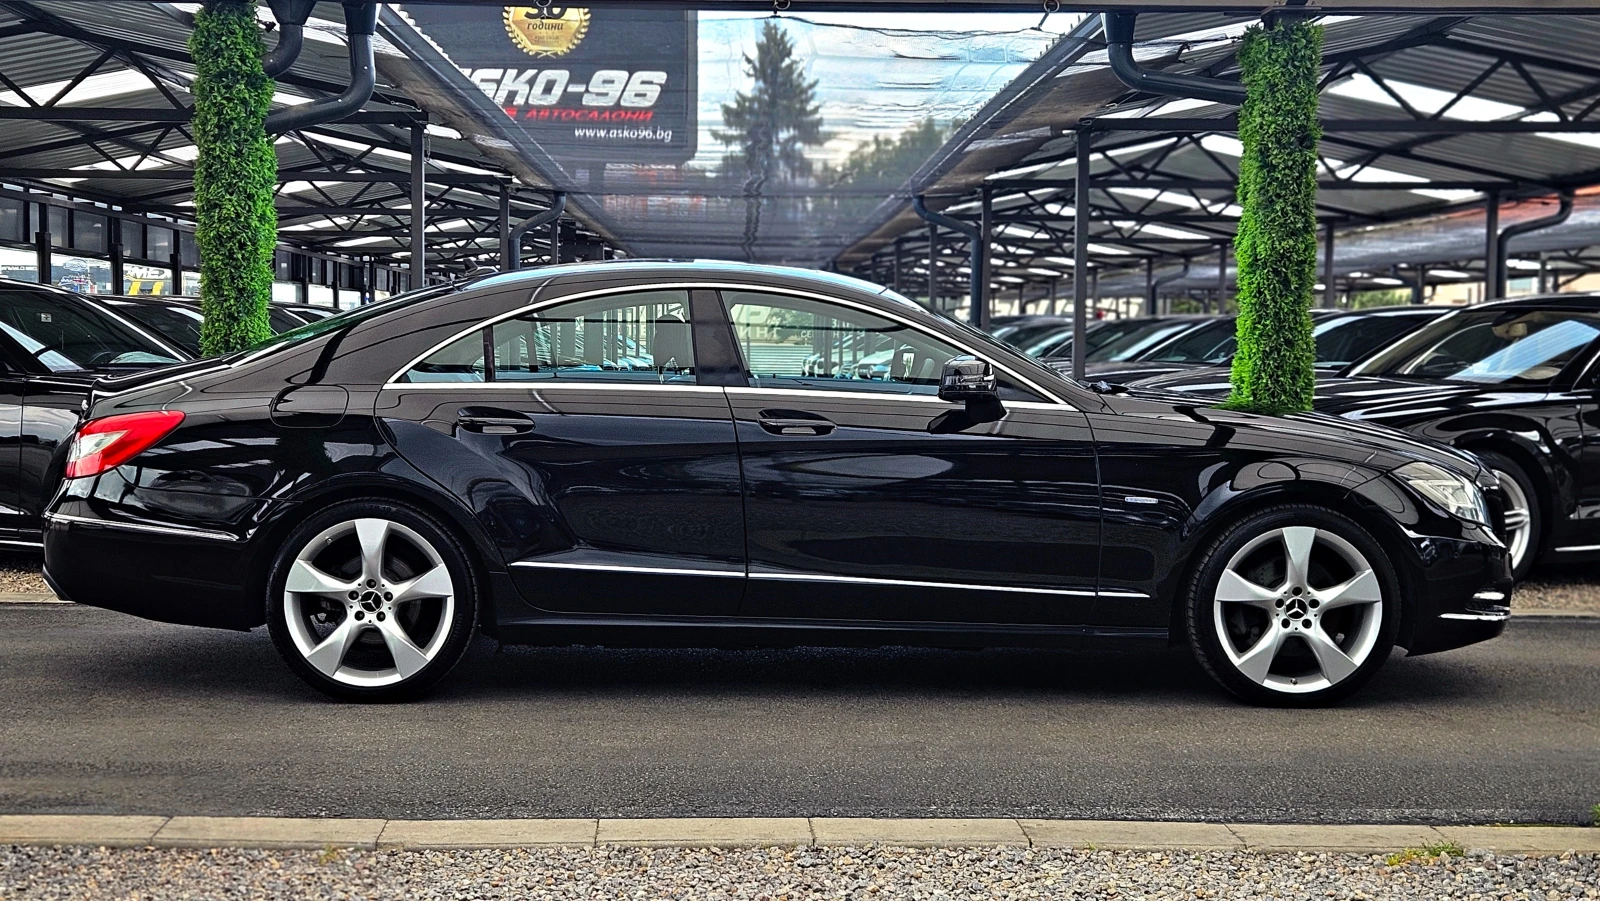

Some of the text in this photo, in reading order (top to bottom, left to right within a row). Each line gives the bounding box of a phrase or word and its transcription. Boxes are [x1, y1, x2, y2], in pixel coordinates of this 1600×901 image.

[527, 21, 564, 31] години
[460, 68, 667, 107] SKO-96
[525, 108, 654, 121] АВТОСАЛОНИ
[574, 126, 672, 143] www.asko96.bg
